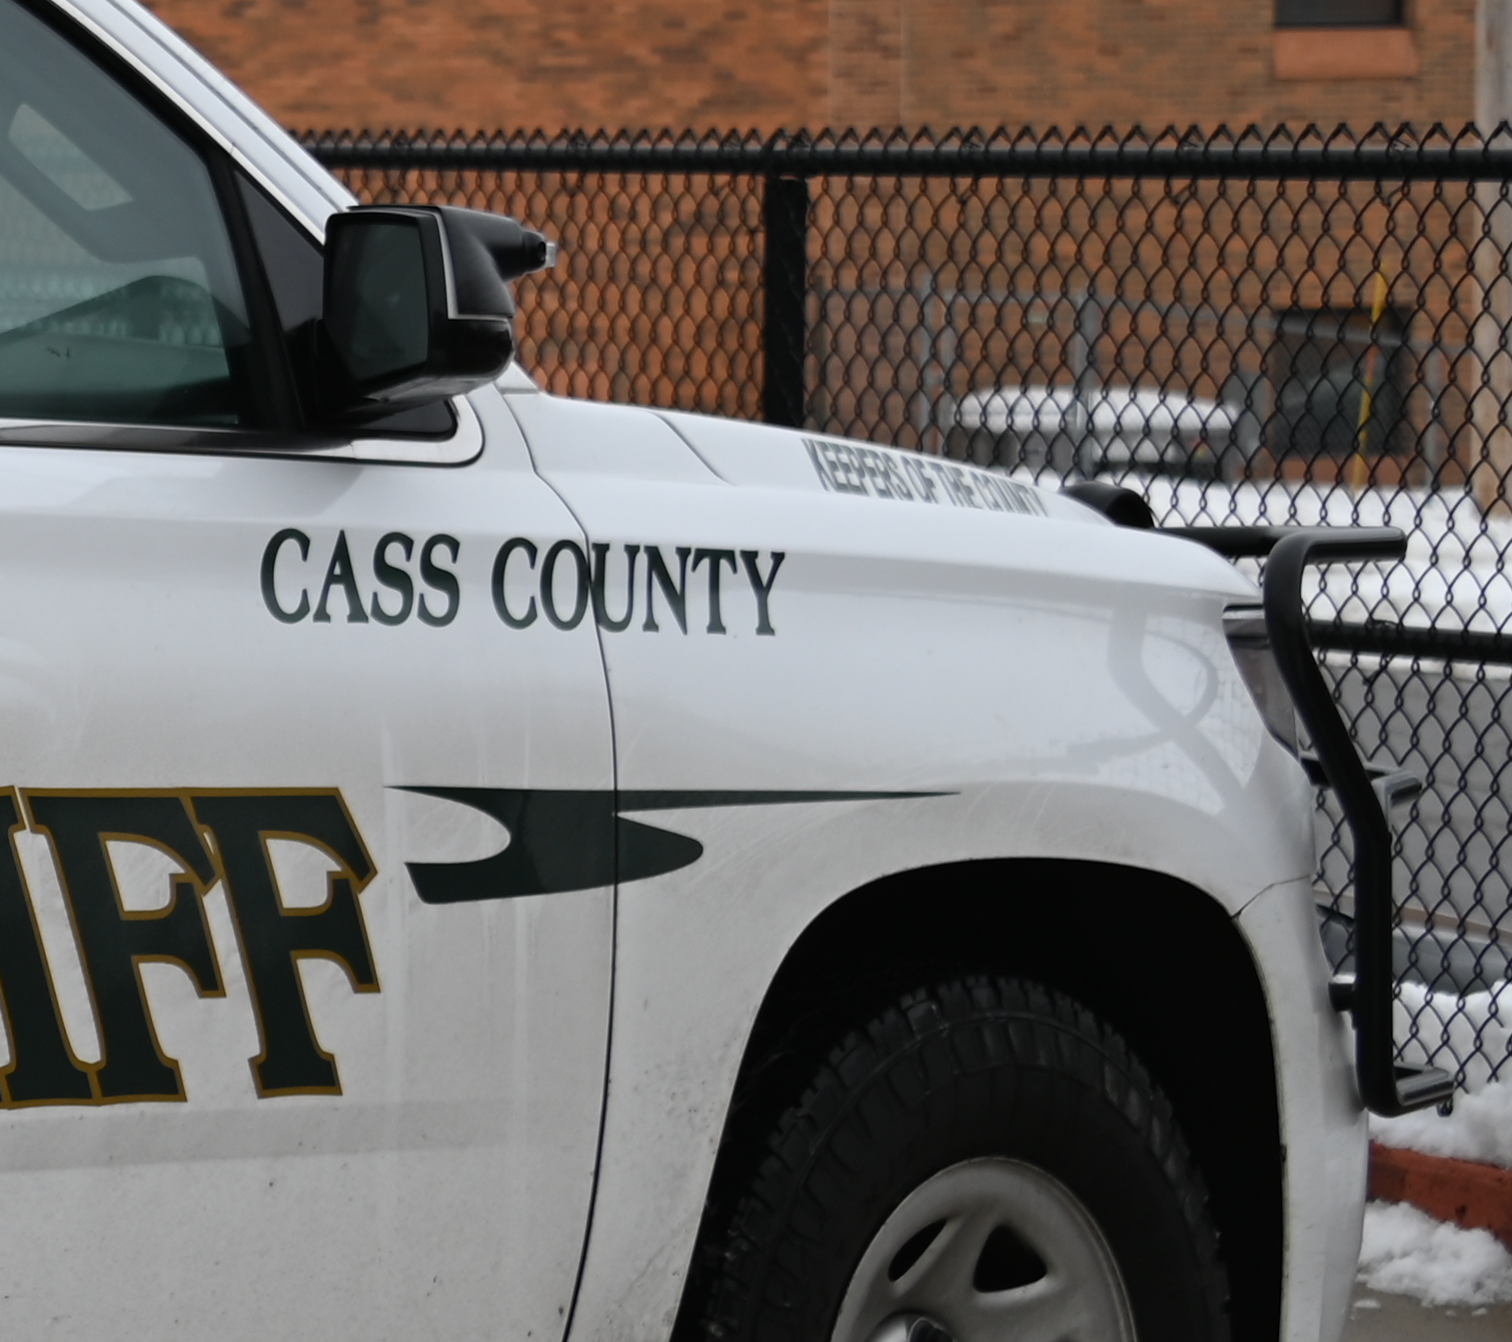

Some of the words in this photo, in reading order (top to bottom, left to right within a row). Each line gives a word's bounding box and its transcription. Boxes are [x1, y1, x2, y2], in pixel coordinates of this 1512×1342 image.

[801, 438, 914, 501] KEEPERS
[900, 455, 939, 505] OF
[925, 461, 984, 510] THE
[260, 528, 461, 627] CASS
[491, 537, 785, 636] COUNTY
